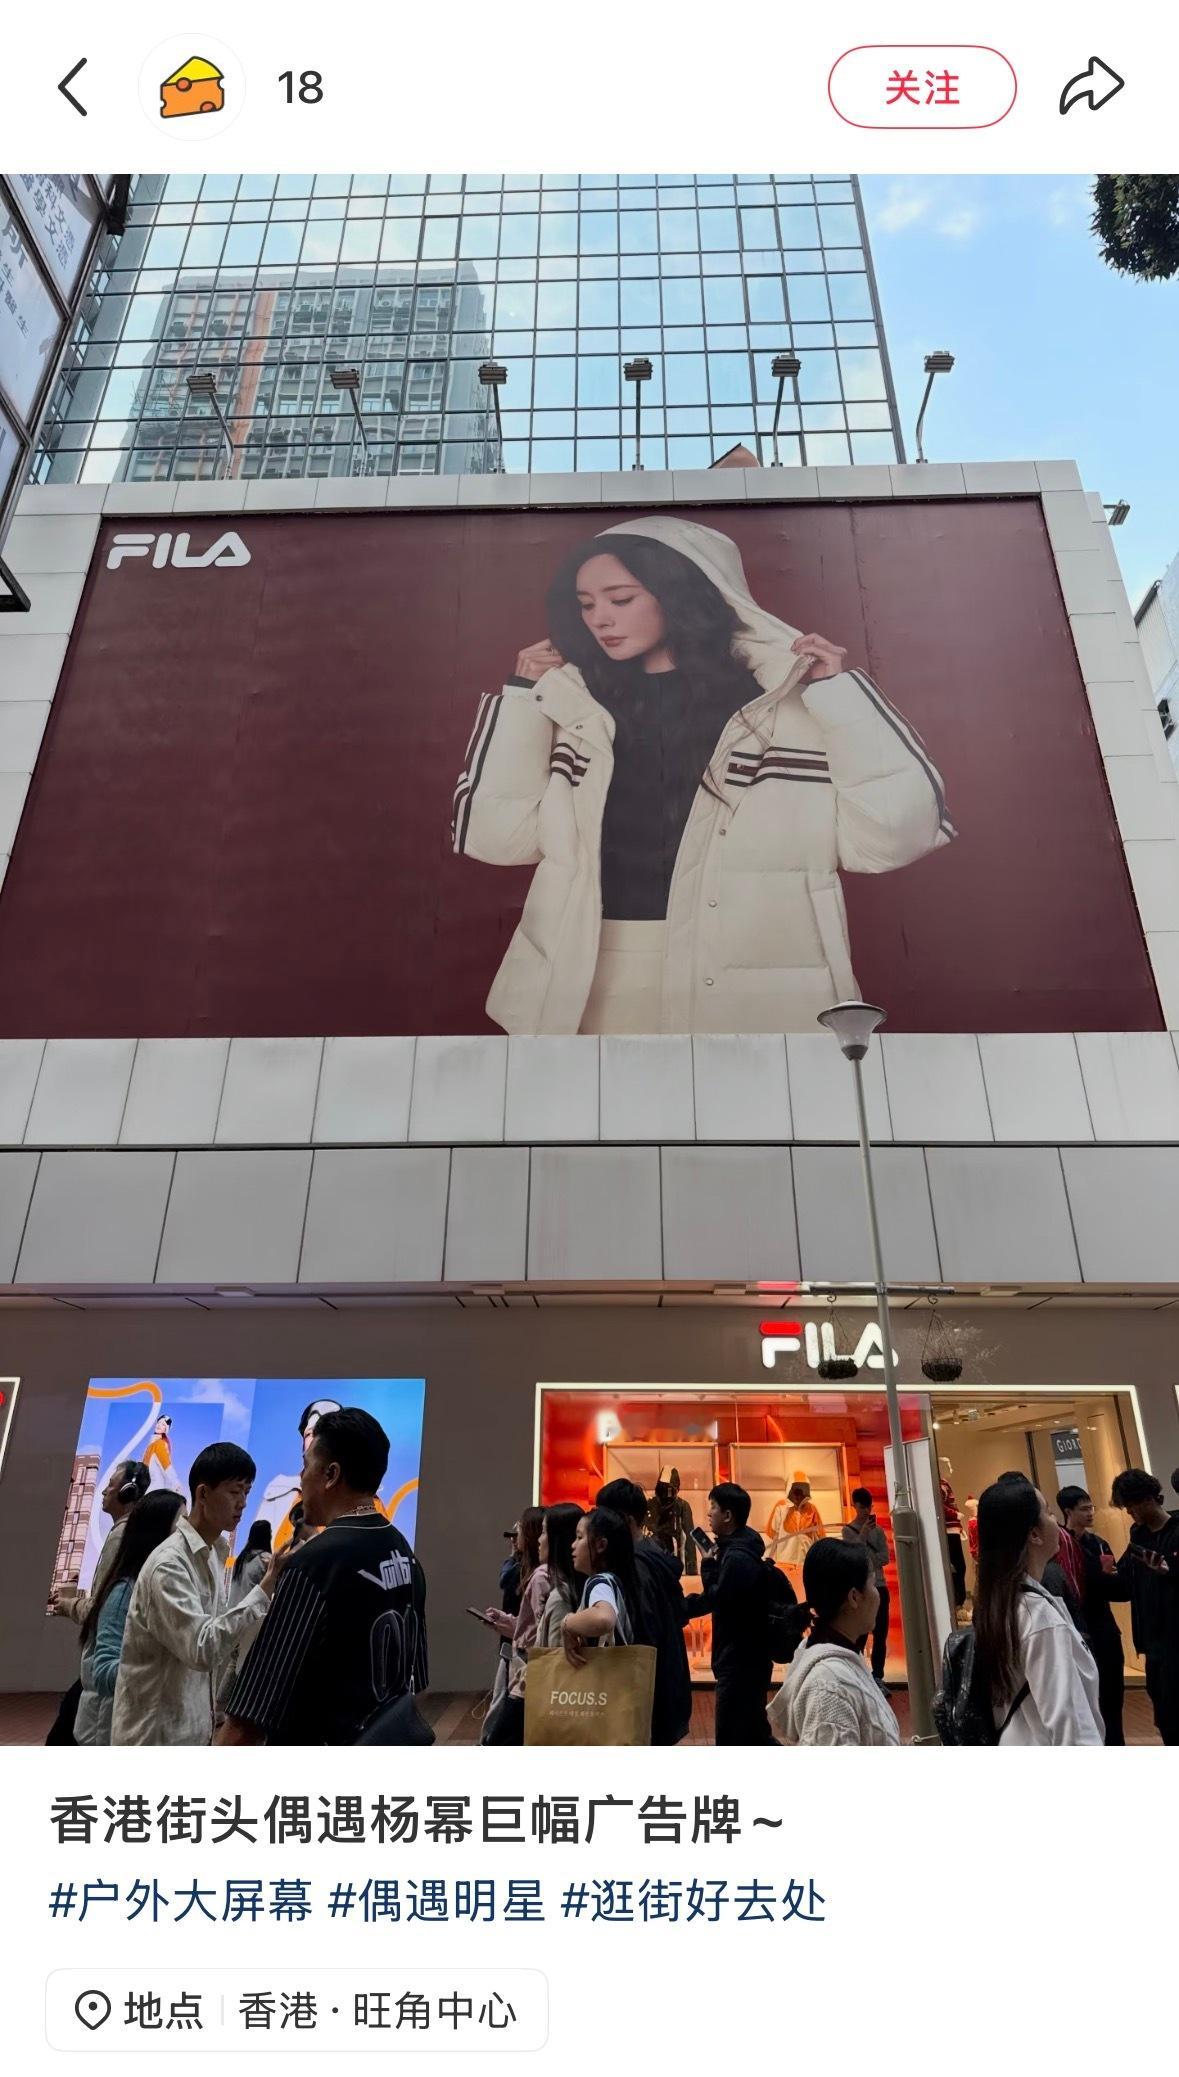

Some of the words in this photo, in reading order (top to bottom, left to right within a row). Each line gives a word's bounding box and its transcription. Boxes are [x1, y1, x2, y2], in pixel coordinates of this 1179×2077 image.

[106, 531, 252, 570] FILA
[759, 1320, 899, 1369] FILA
[550, 1690, 608, 1706] FOCUS.S
